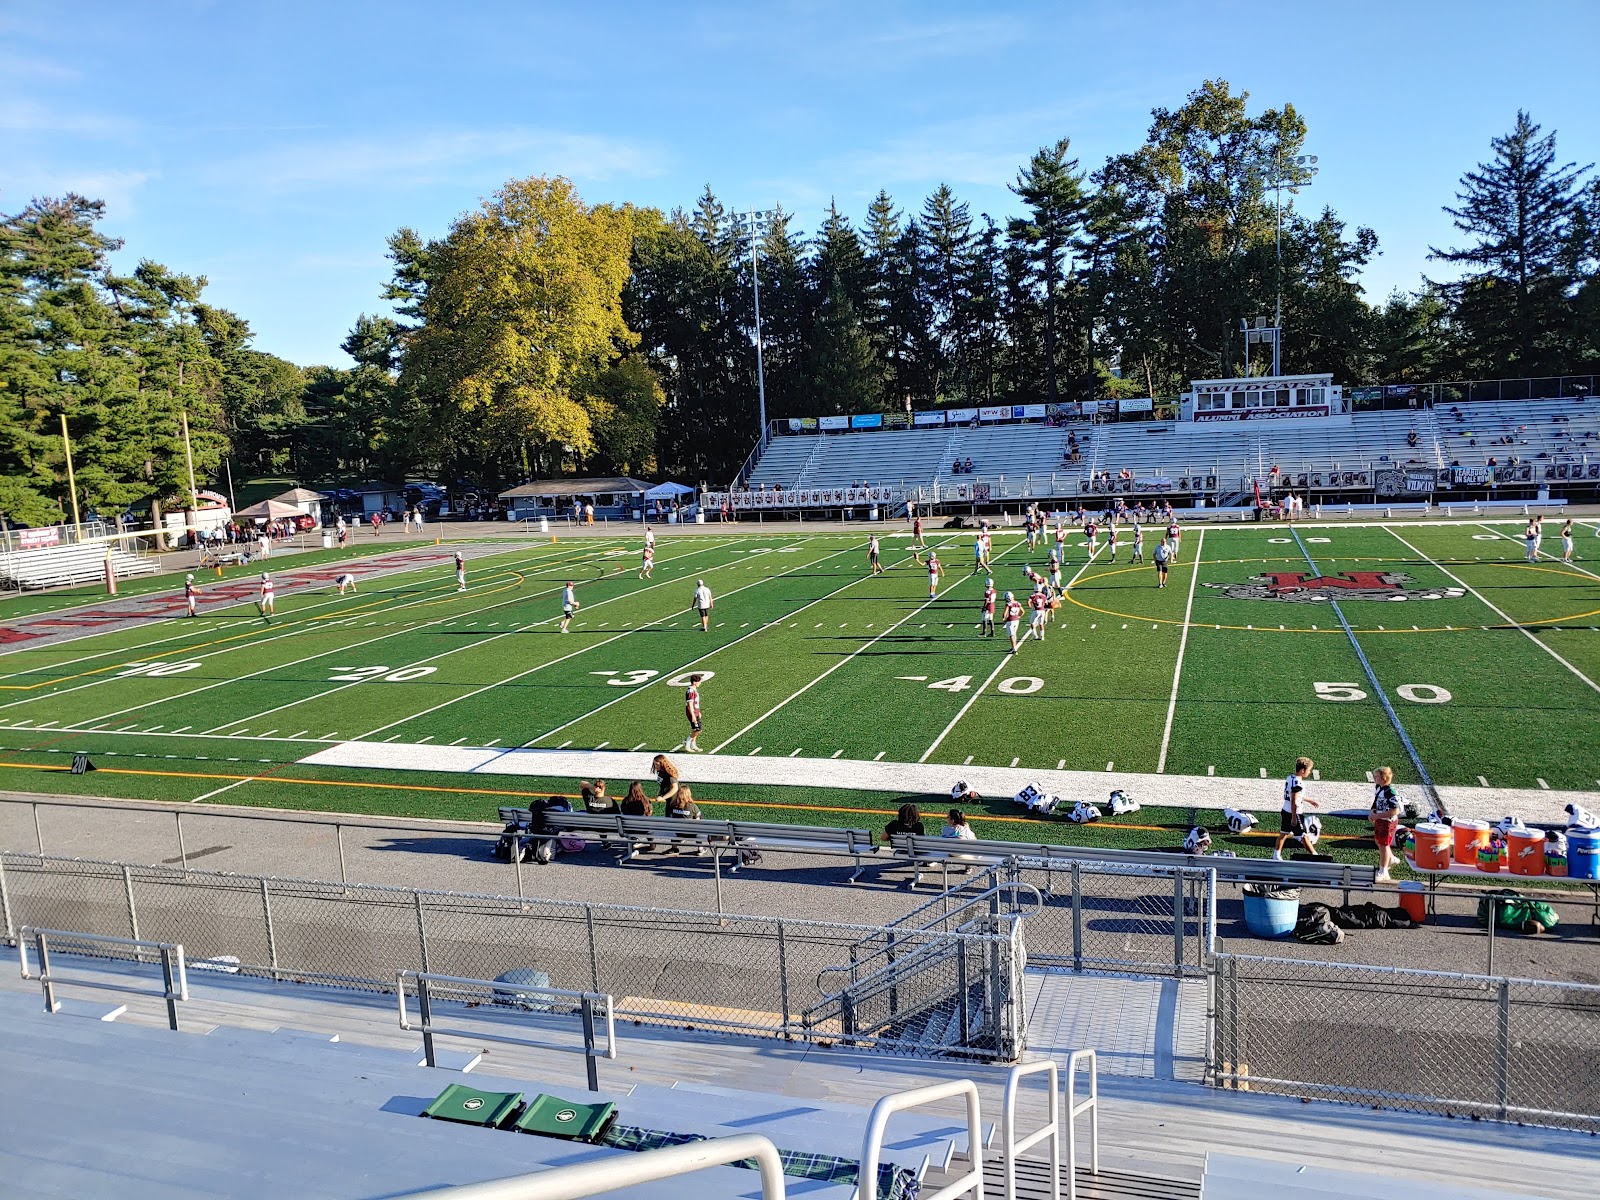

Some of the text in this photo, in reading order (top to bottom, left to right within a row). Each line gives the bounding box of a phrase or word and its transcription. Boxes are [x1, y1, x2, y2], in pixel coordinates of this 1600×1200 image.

[1205, 381, 1317, 393] WILDCATS
[1197, 410, 1326, 422] ALUMNI ASSOCIATION
[1455, 468, 1492, 477] YEARBOOKS
[1455, 475, 1463, 483] ON
[1463, 475, 1477, 483] SALE
[1407, 480, 1435, 492] WILDCATS
[327, 665, 438, 682] 20
[606, 669, 716, 687] 30
[926, 675, 1046, 694] 40
[1313, 681, 1453, 704] 50
[71, 755, 86, 774] 20
[1018, 785, 1038, 802] 83
